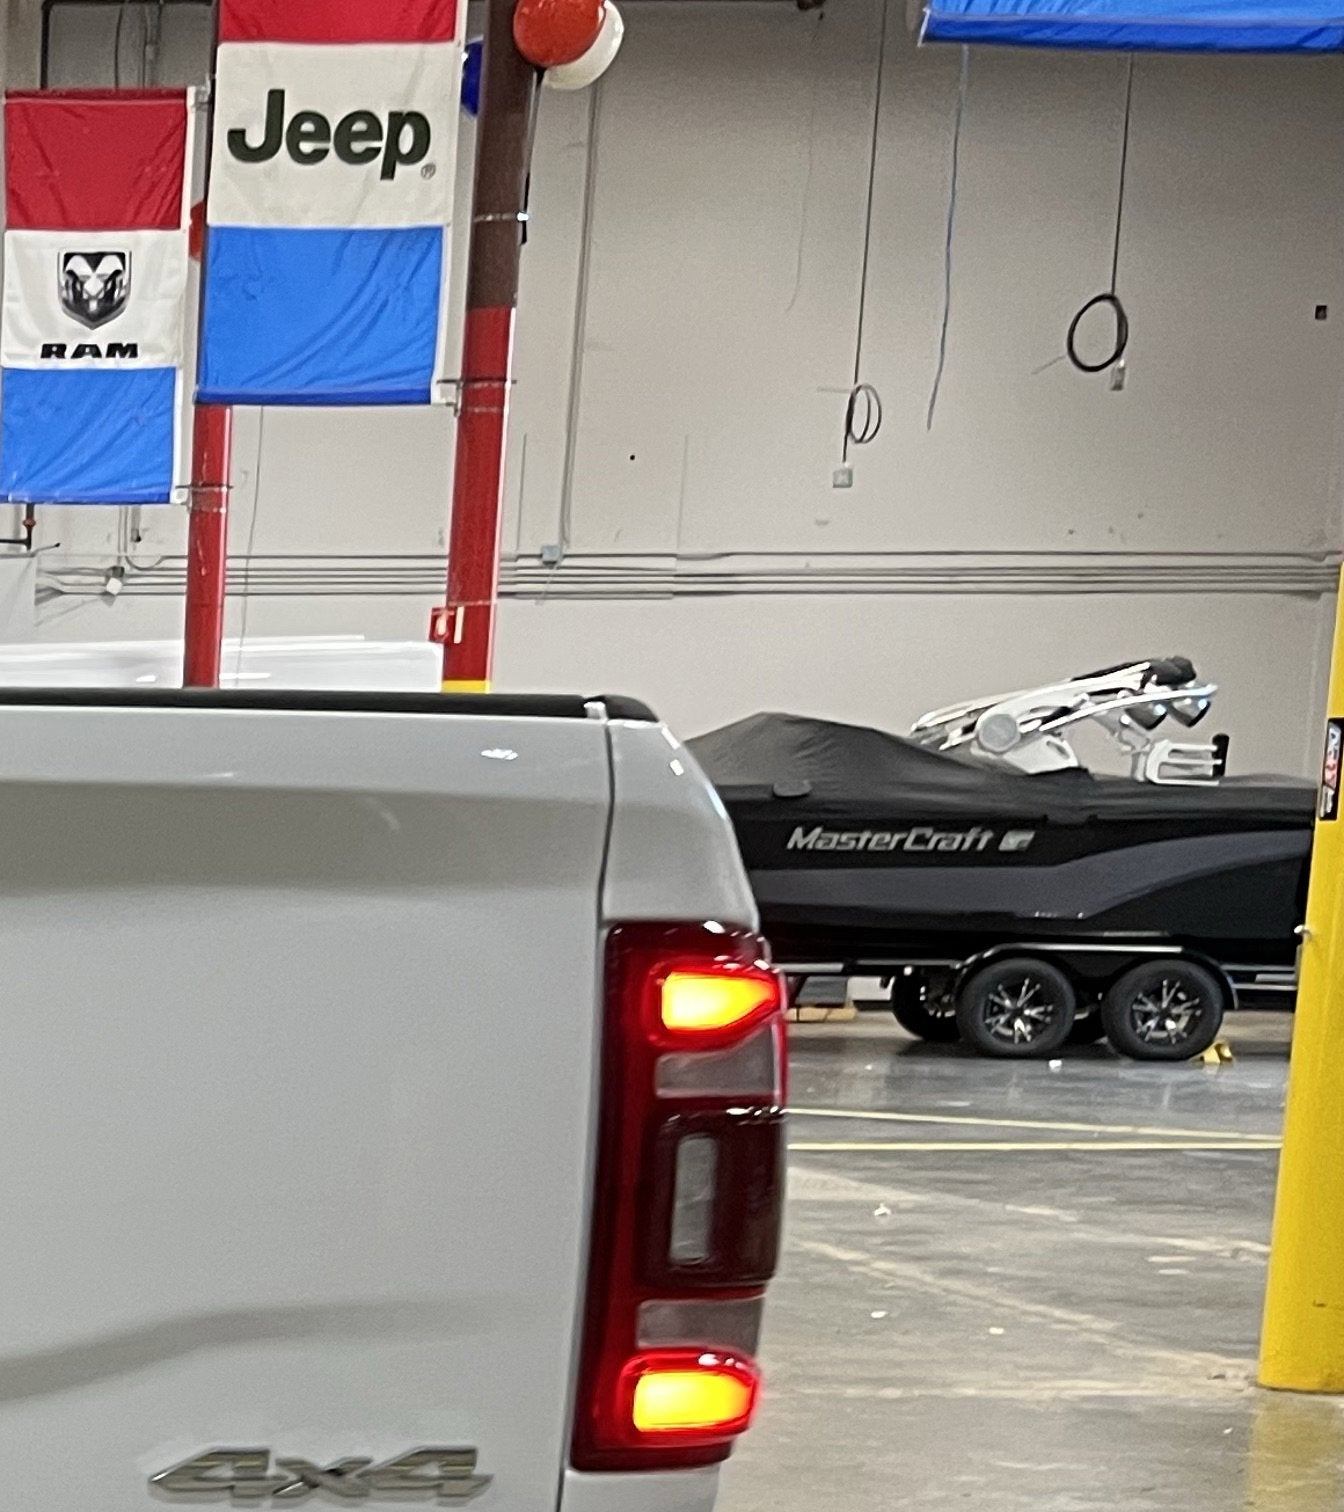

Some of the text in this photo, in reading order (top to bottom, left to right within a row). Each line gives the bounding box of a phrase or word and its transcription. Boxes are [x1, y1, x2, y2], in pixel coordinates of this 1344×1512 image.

[227, 89, 431, 180] Jeep
[40, 342, 139, 360] RAM
[787, 826, 994, 851] MasterCraft
[148, 1446, 494, 1502] 4x4
